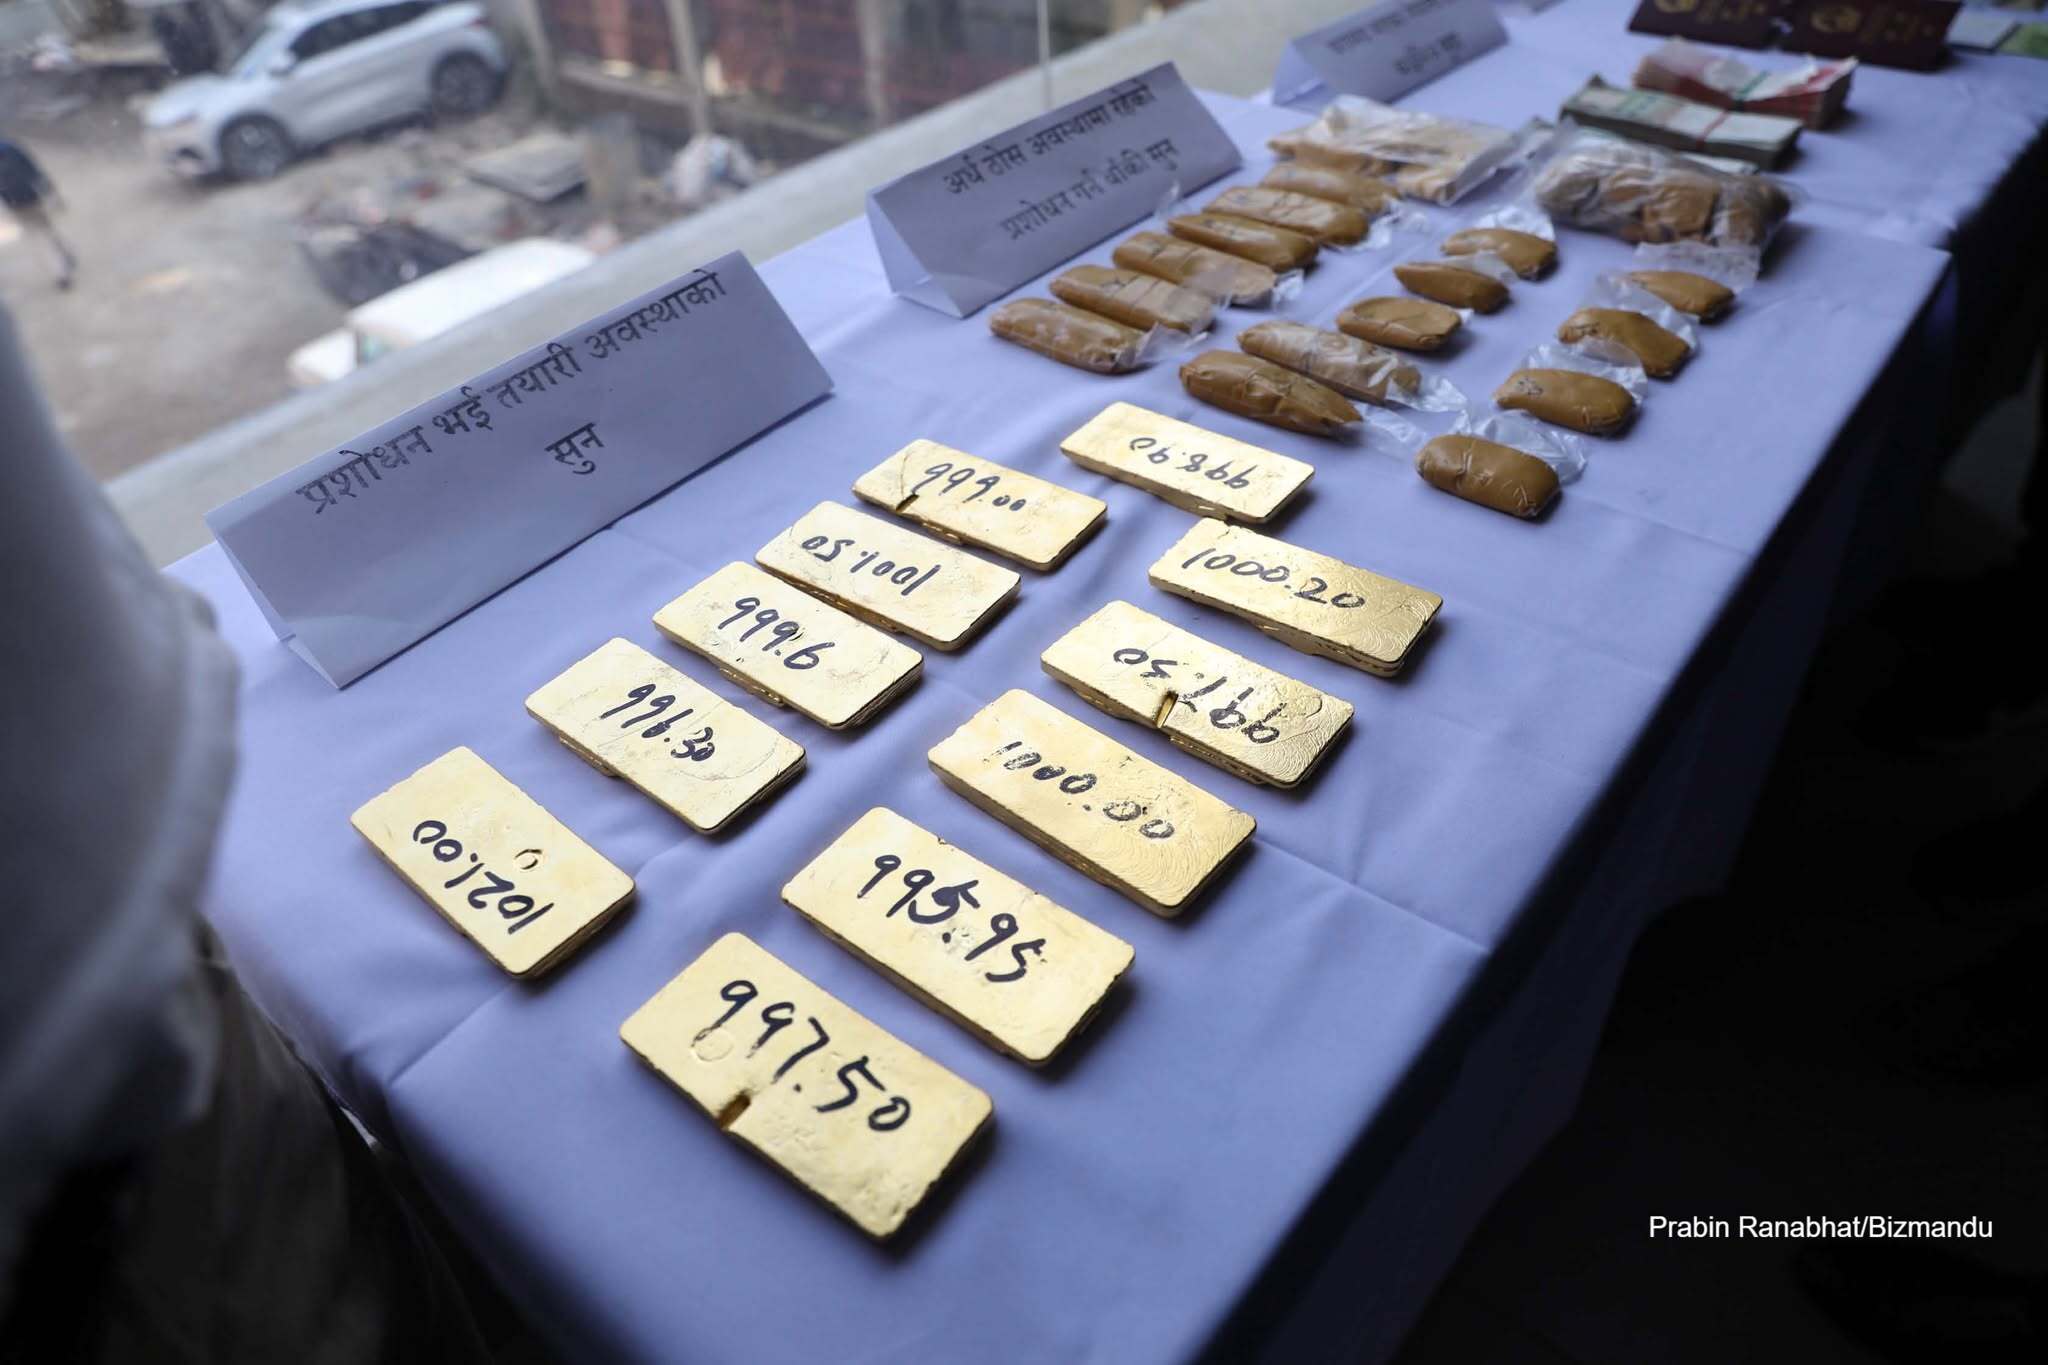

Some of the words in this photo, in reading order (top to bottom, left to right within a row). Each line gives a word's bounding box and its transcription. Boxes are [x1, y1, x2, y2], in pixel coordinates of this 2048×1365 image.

[296, 424, 433, 514] प्रशोधन
[432, 386, 493, 434] भई
[486, 343, 582, 409] तयारी
[584, 269, 727, 359] अवस्थाको
[544, 422, 605, 475] सुन
[911, 463, 1026, 511] 999.00
[801, 535, 941, 596] 1001.50
[1181, 548, 1365, 609] 1000.20
[718, 597, 835, 670] 999.6
[984, 741, 1175, 840] 1000.00
[412, 820, 554, 935] 1021.00
[857, 854, 1047, 982] 995.95
[691, 979, 912, 1131] 997.50
